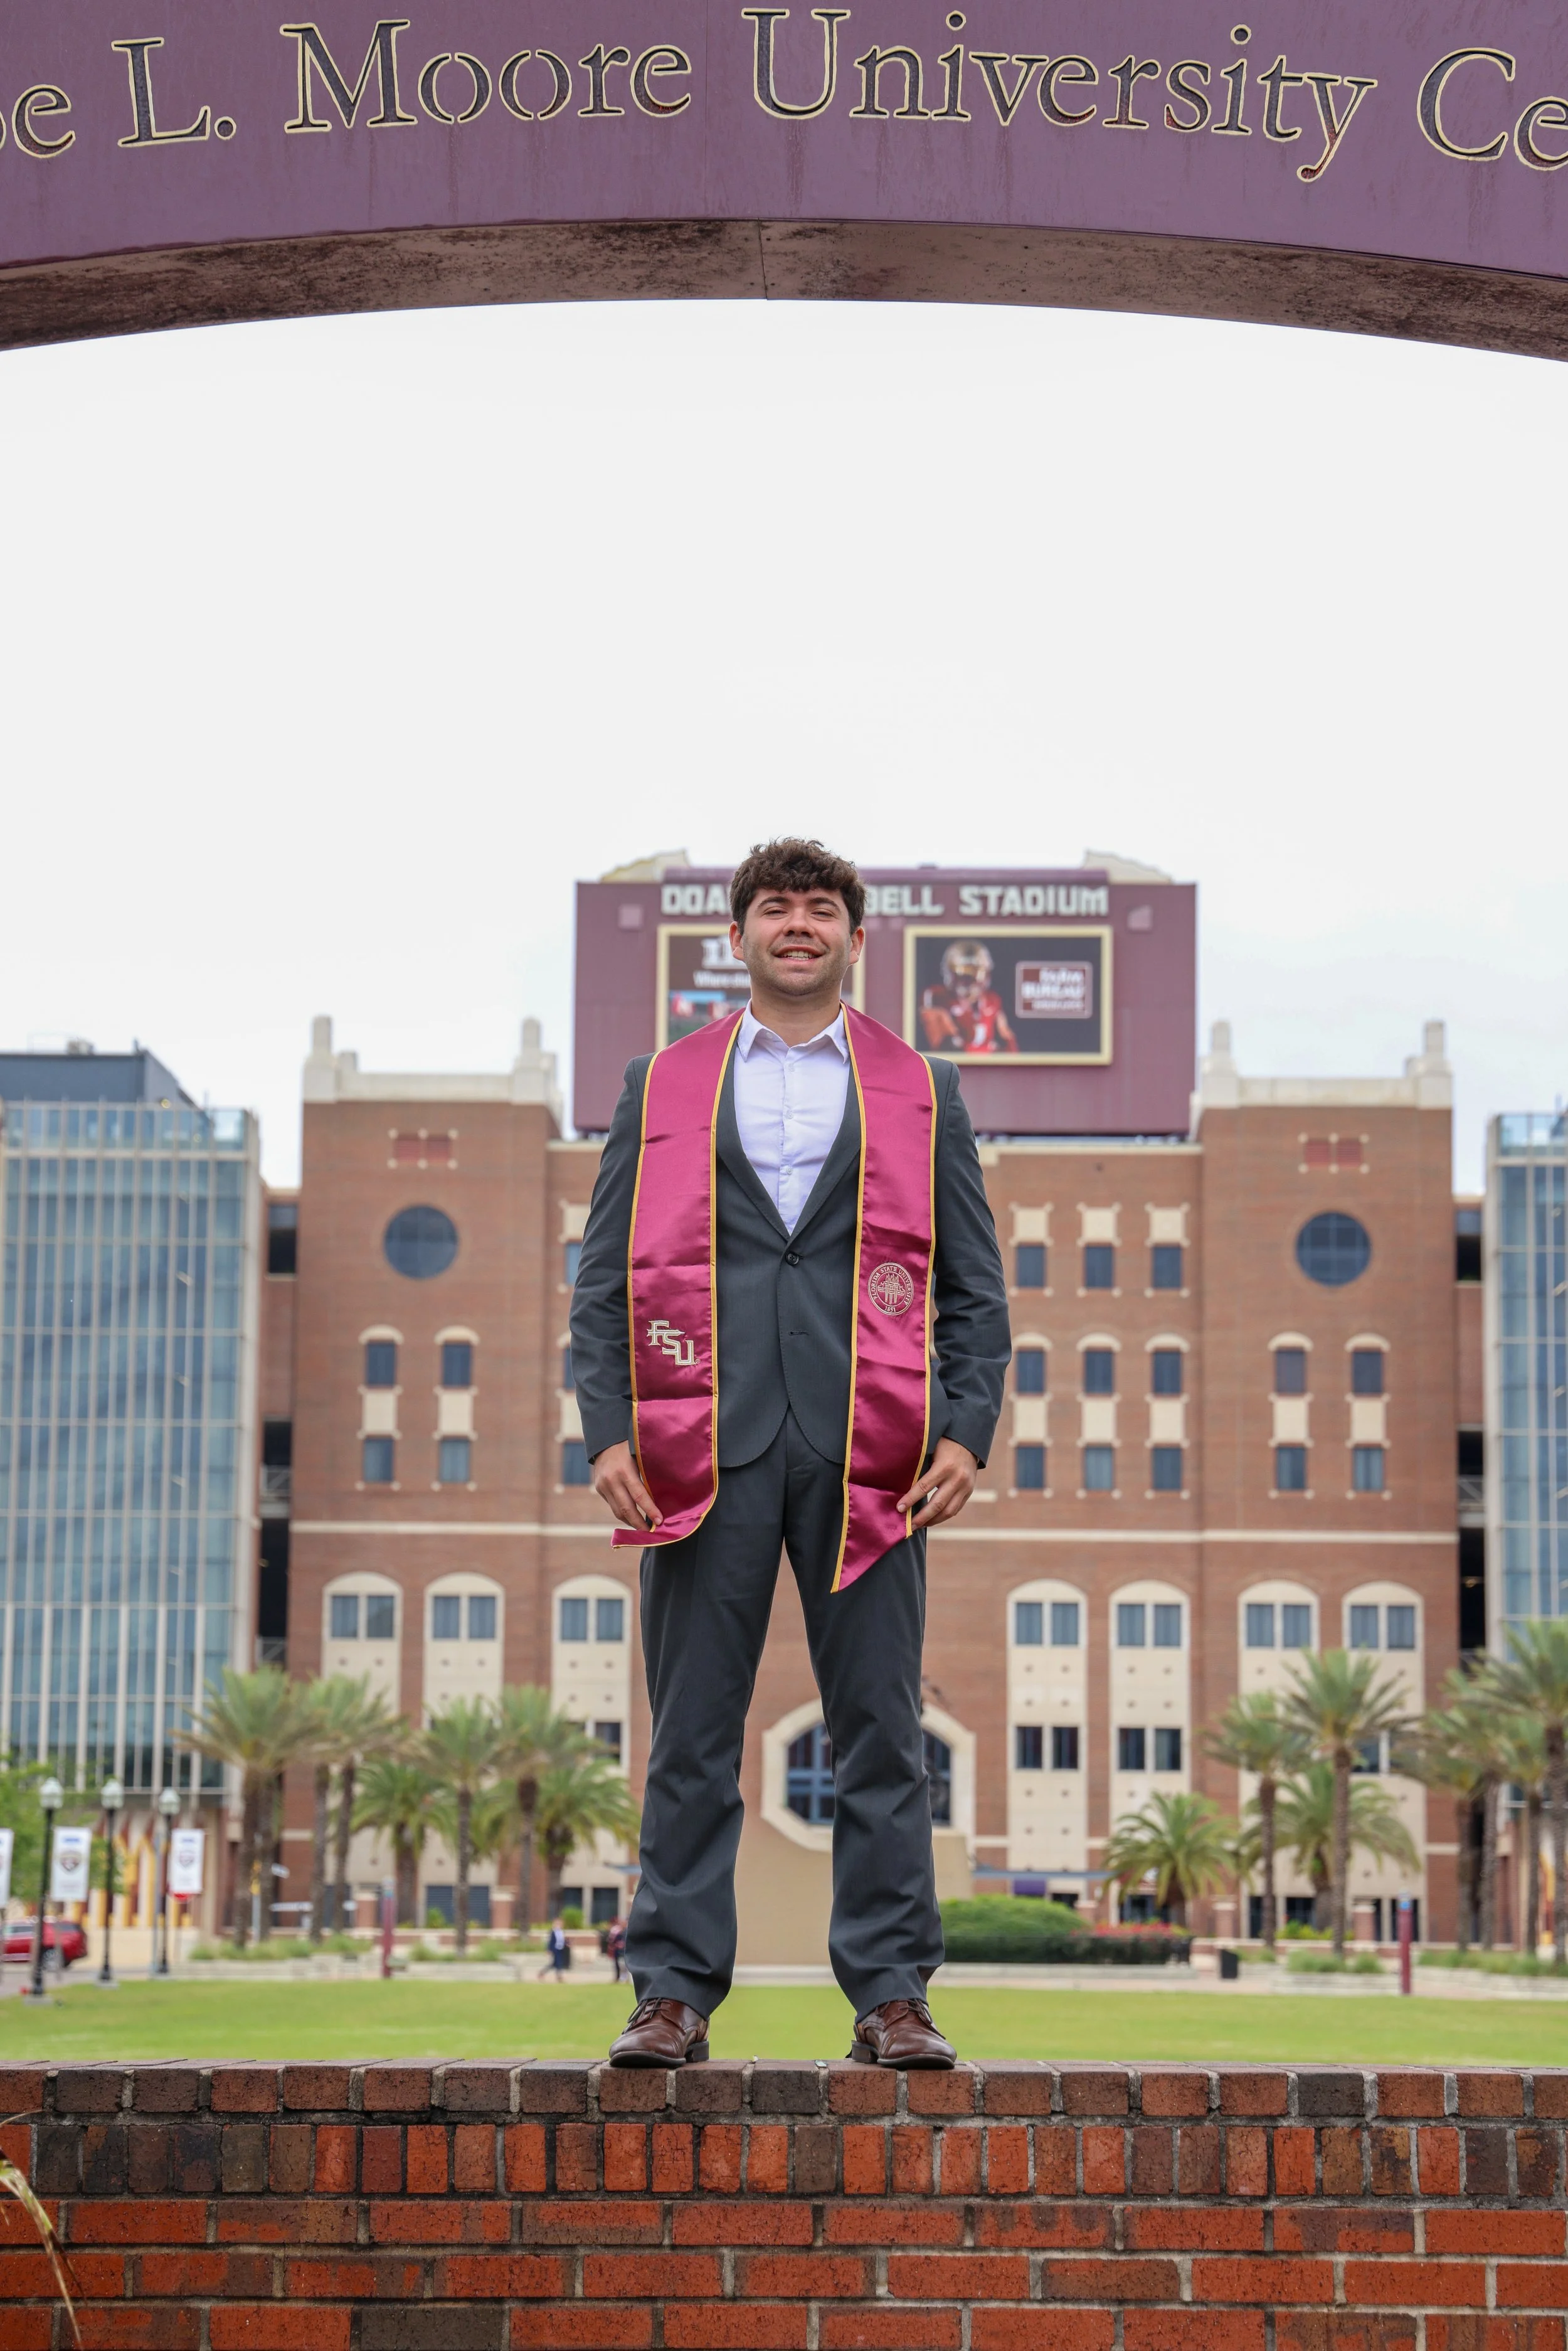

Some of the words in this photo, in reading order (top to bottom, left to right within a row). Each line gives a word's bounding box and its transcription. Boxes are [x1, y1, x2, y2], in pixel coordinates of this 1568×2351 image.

[0, 84, 76, 158] e
[112, 37, 236, 147] L.
[280, 19, 692, 133] Moore
[742, 8, 1378, 182] University
[1416, 47, 1568, 171] Ce
[661, 884, 732, 915] DOA
[959, 884, 1109, 916] STADIUM
[871, 1272, 881, 1300] FLORIDA
[898, 1269, 911, 1305] UNIVERSITY
[647, 1320, 697, 1365] FSU
